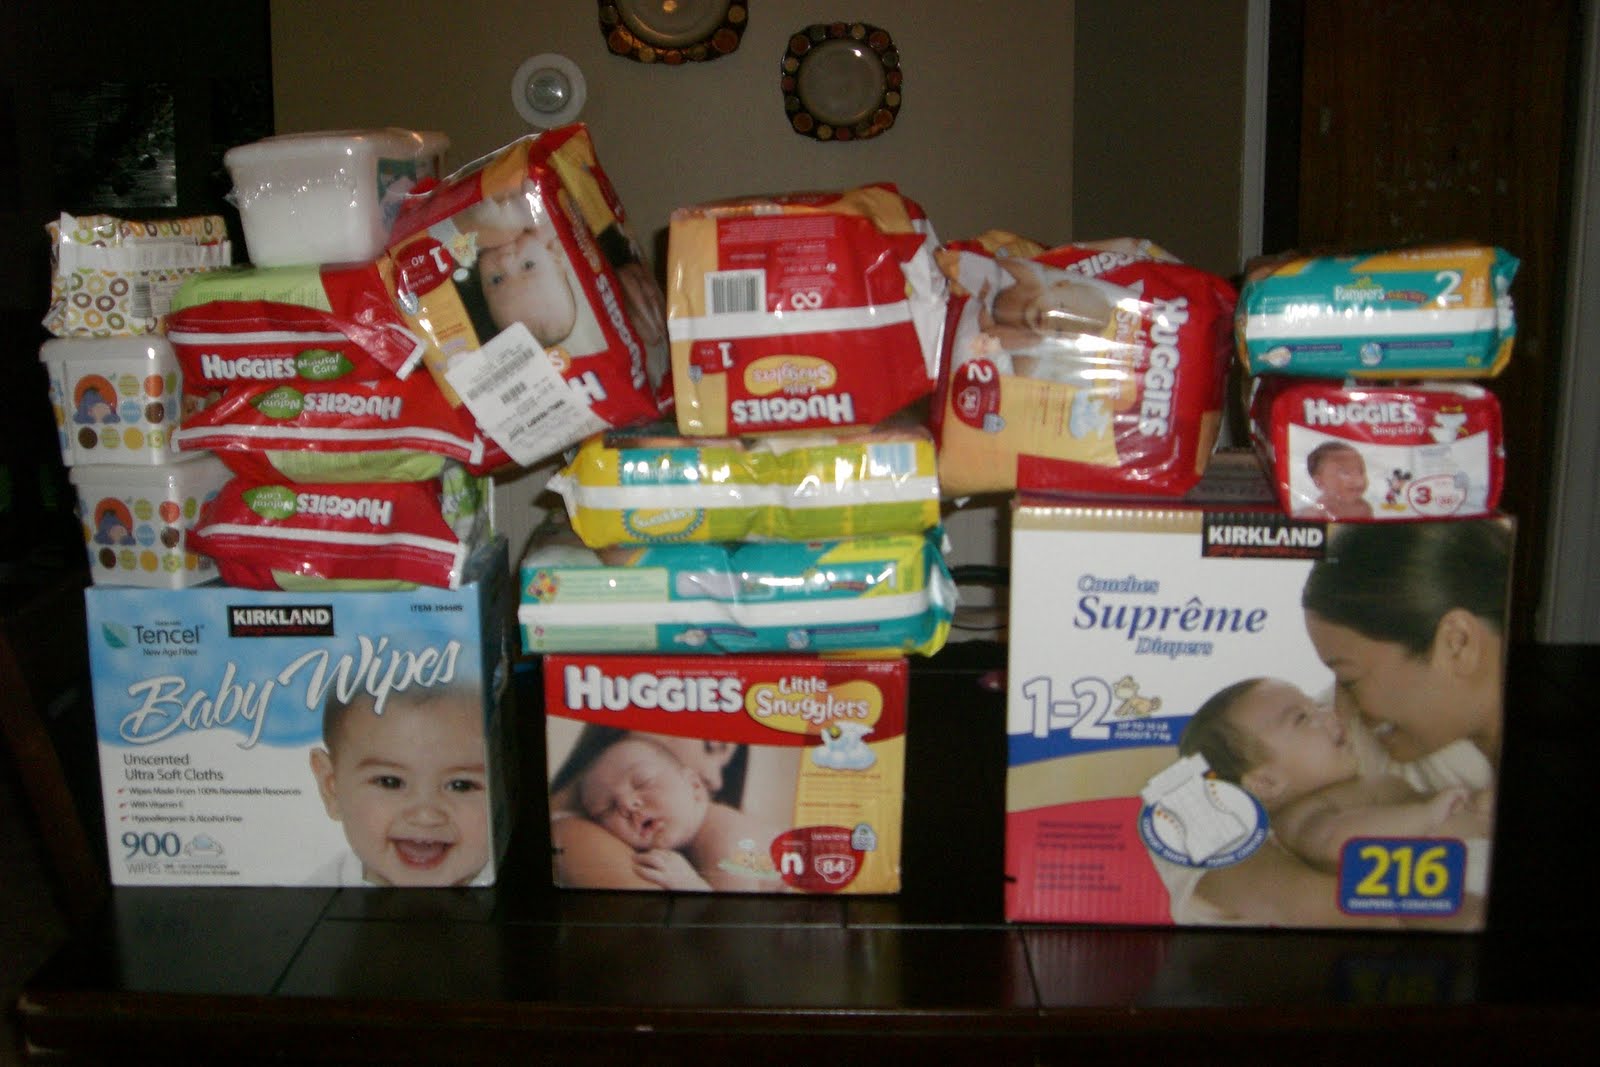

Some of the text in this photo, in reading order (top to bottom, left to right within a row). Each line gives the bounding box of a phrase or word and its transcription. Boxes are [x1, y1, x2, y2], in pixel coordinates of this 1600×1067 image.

[411, 255, 425, 266] 40
[429, 247, 448, 273] 1
[1334, 285, 1384, 303] Pampers
[1435, 270, 1463, 304] 2
[201, 353, 296, 379] HUGGIES
[313, 364, 338, 375] Care
[718, 342, 734, 368] 1
[1138, 297, 1189, 437] HUGGIES
[967, 362, 992, 383] 2
[303, 393, 401, 420] HUGGIES
[731, 393, 855, 424] HUGGIES
[1303, 398, 1416, 426] HUGGIES
[1415, 486, 1432, 505] 3
[296, 493, 392, 526] HUGGIES
[1208, 525, 1324, 547] KIRKLAND
[233, 608, 331, 625] KIRKLAND
[1073, 595, 1268, 640] Suprême
[133, 624, 200, 644] Tencel
[143, 648, 198, 658] New Age Fiber
[119, 635, 462, 750] Baby Wipes
[564, 664, 870, 724] HUGGIES Little Snugglers
[1022, 676, 1112, 740] 1-2
[123, 753, 190, 766] Unscented
[125, 768, 224, 781] Ultra Soft Cloths
[129, 787, 151, 796] Wipes
[153, 787, 175, 795] Made
[176, 787, 196, 795] From
[198, 787, 218, 795] 100%
[263, 788, 301, 796] Resources
[132, 814, 187, 824] Hypoallergenic
[196, 814, 225, 823] Alcohol
[226, 815, 243, 823] Free
[121, 832, 181, 859] 900
[126, 863, 161, 875] WIPES
[781, 852, 845, 875] n 84
[1355, 845, 1449, 897] 216
